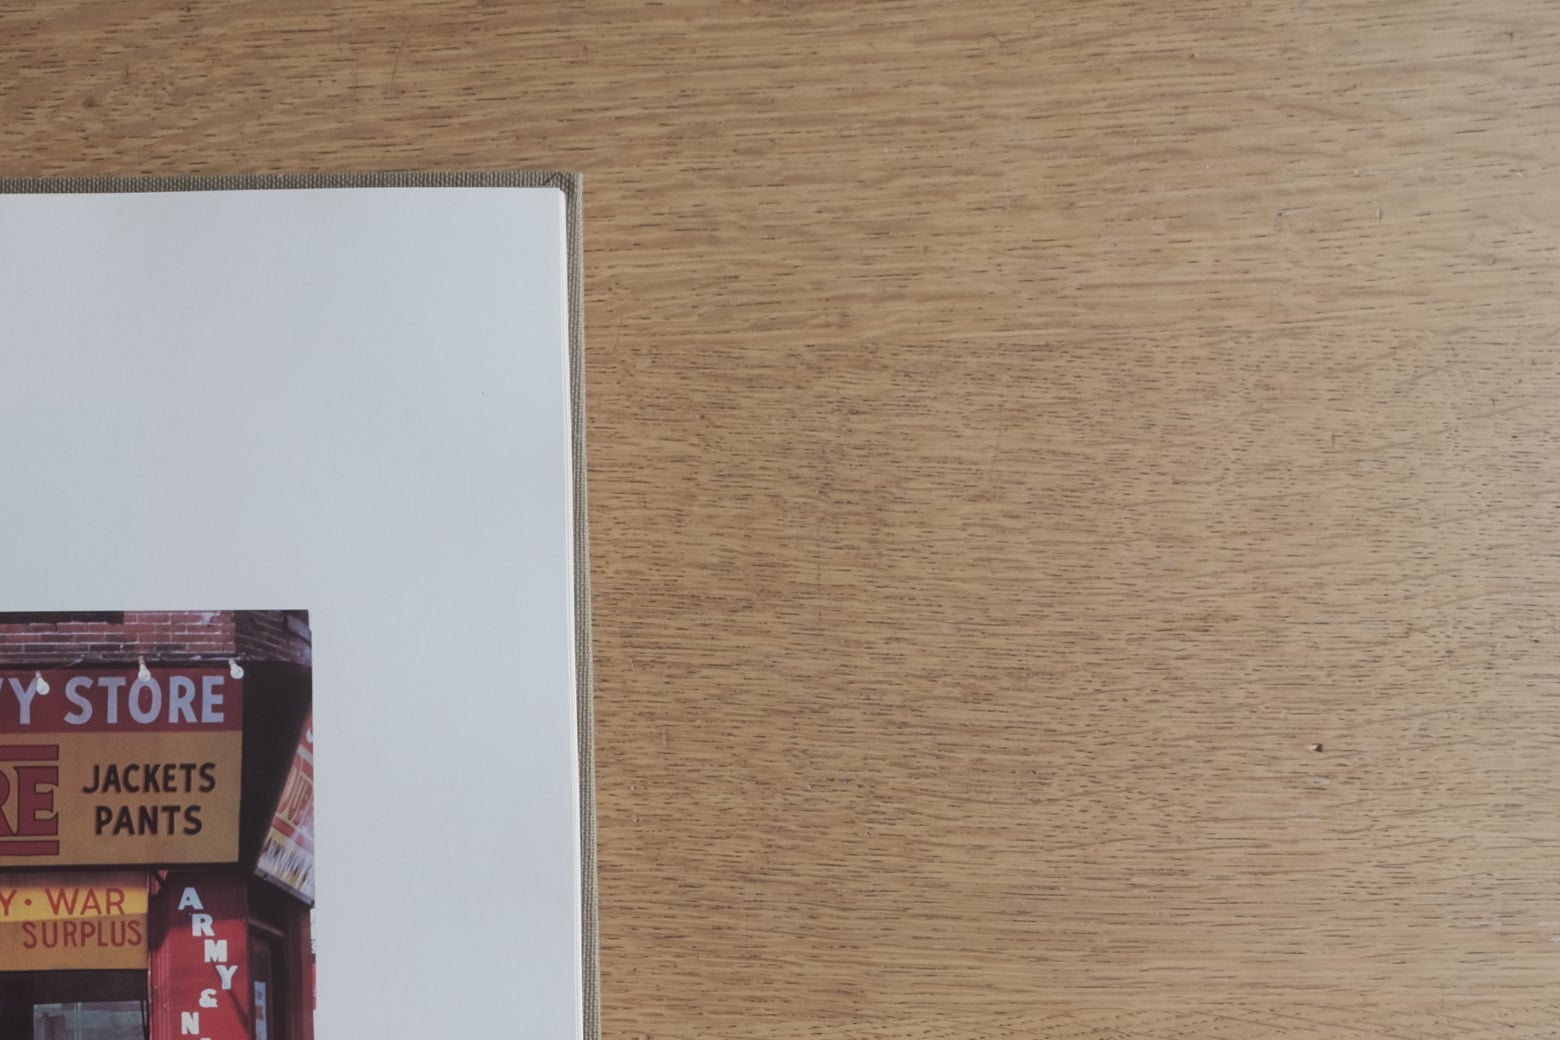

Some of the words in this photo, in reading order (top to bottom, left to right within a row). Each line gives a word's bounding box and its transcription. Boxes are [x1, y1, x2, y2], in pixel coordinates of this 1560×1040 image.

[64, 675, 225, 725] STORE
[82, 763, 216, 793] JACKETS
[95, 805, 203, 836] PANTS
[45, 888, 126, 916] WAR
[22, 920, 143, 949] SURPLUS
[177, 887, 238, 990] ARMY
